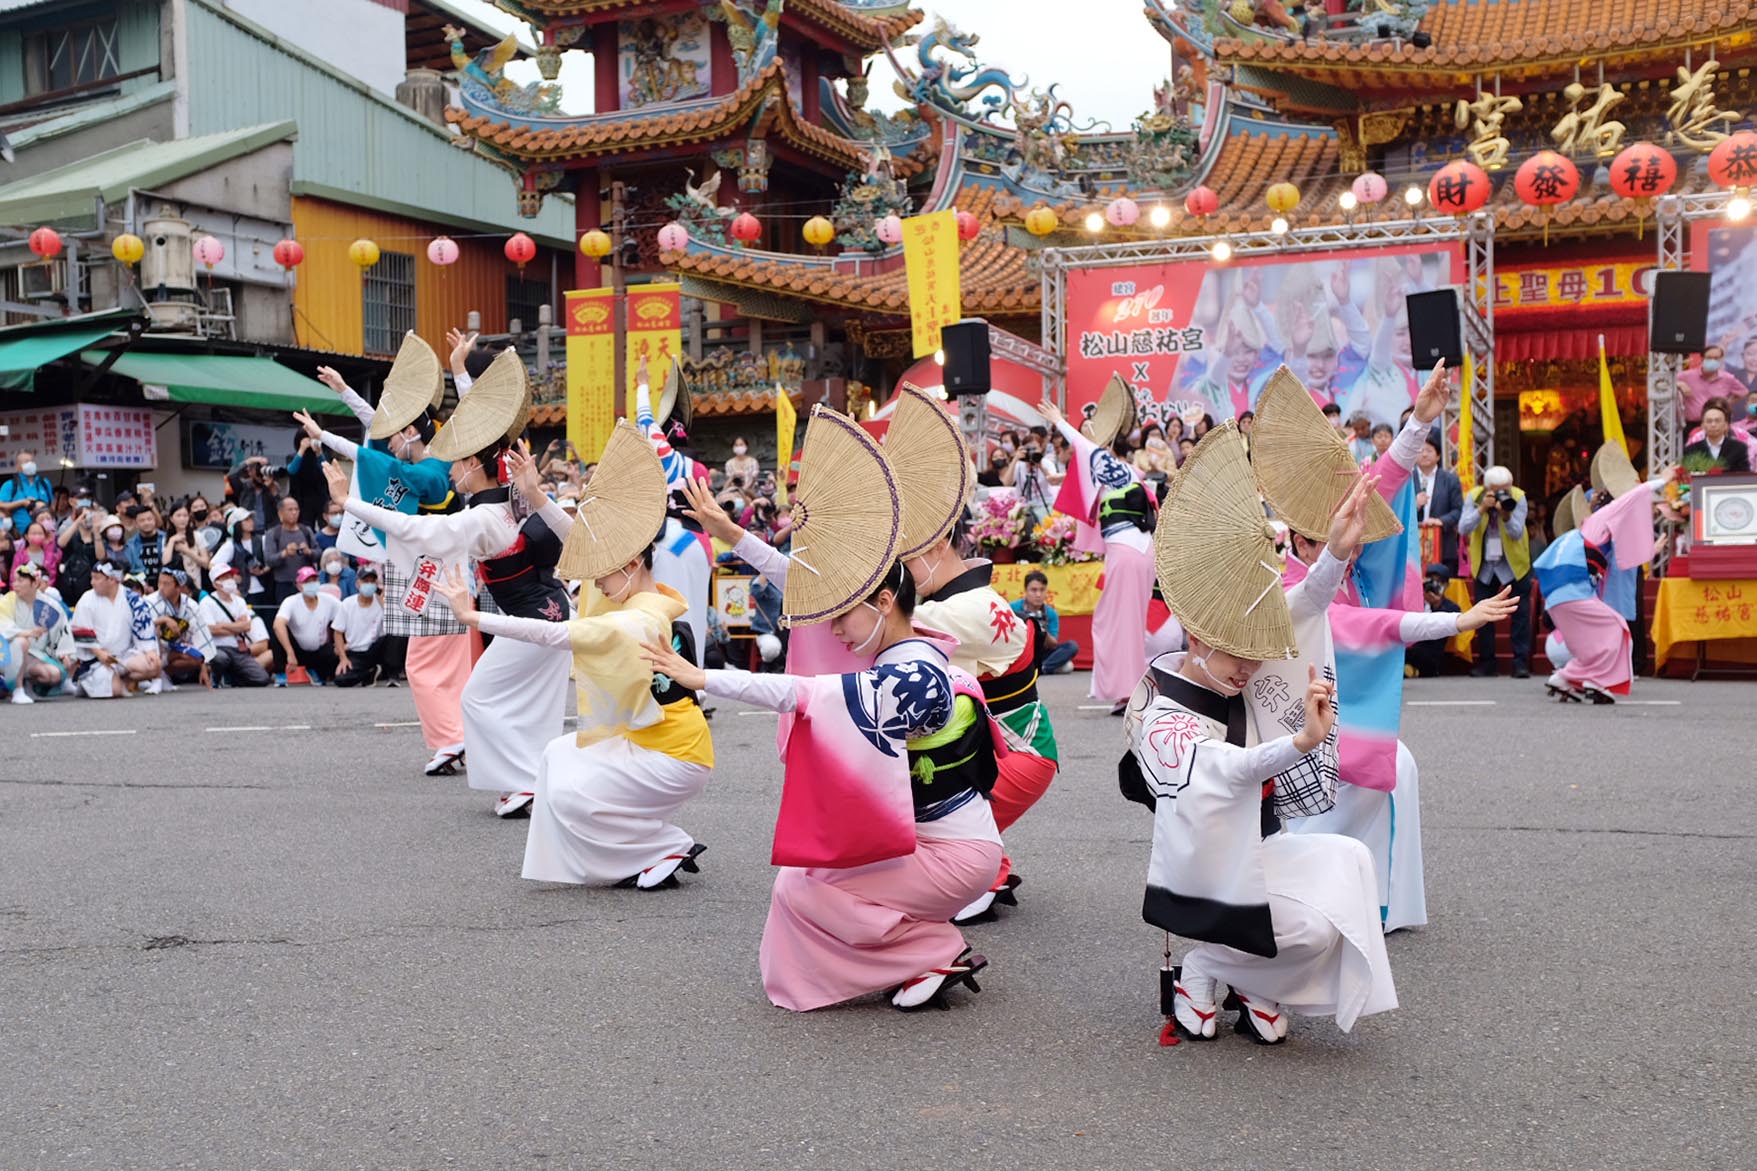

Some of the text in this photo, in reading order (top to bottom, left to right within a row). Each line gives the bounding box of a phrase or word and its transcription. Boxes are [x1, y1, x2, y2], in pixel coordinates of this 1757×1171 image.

[1436, 172, 1473, 206] 財
[1530, 165, 1568, 199] 發
[1081, 328, 1203, 357] 松山慈祐宮
[1134, 363, 1147, 380] X
[1703, 583, 1743, 602] 松山
